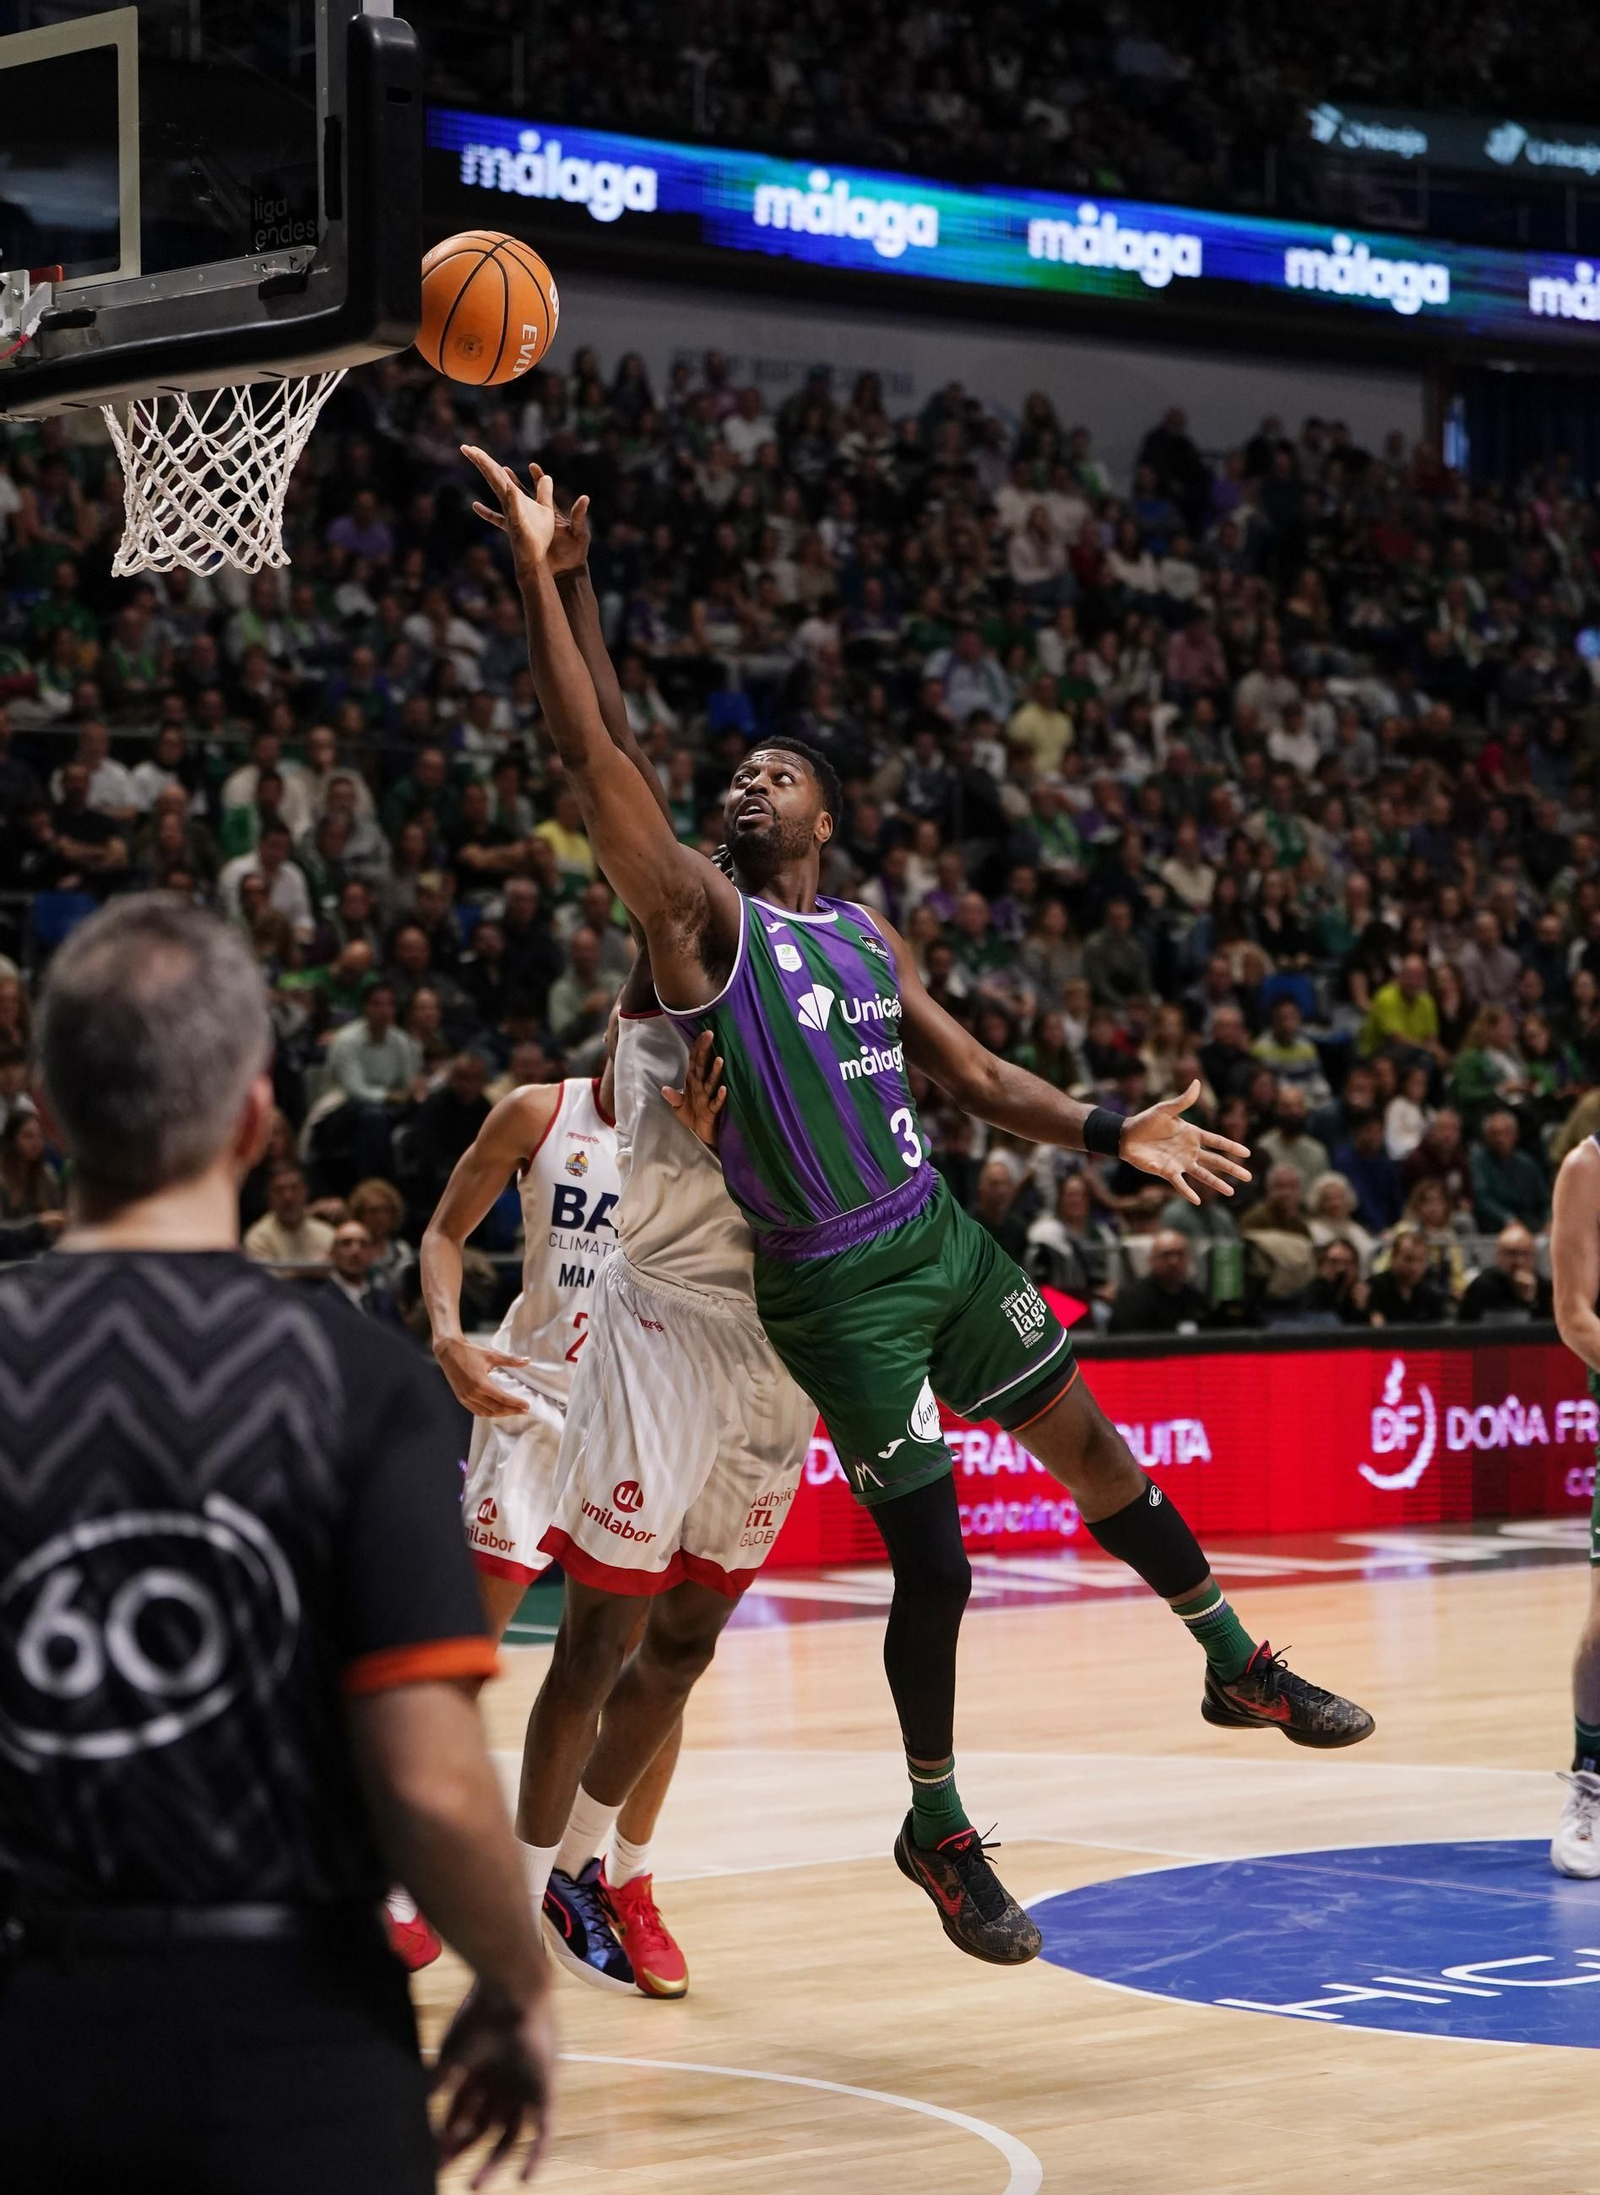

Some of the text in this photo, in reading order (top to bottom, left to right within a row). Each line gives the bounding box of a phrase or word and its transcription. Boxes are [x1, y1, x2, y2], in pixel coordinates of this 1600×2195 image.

[255, 217, 318, 248] endes
[754, 169, 938, 257] málaga
[1028, 202, 1201, 288] málaga
[1285, 234, 1449, 314] málaga
[1529, 261, 1600, 322] má
[838, 1042, 904, 1081] málag
[890, 1107, 923, 1168] 3
[1000, 1289, 1019, 1311] sabor
[1004, 1308, 1014, 1318] a
[1010, 1297, 1047, 1338] laga
[1446, 1394, 1550, 1450] DOÑA
[464, 1524, 516, 1553] nilabor
[581, 1497, 657, 1544] unilabor
